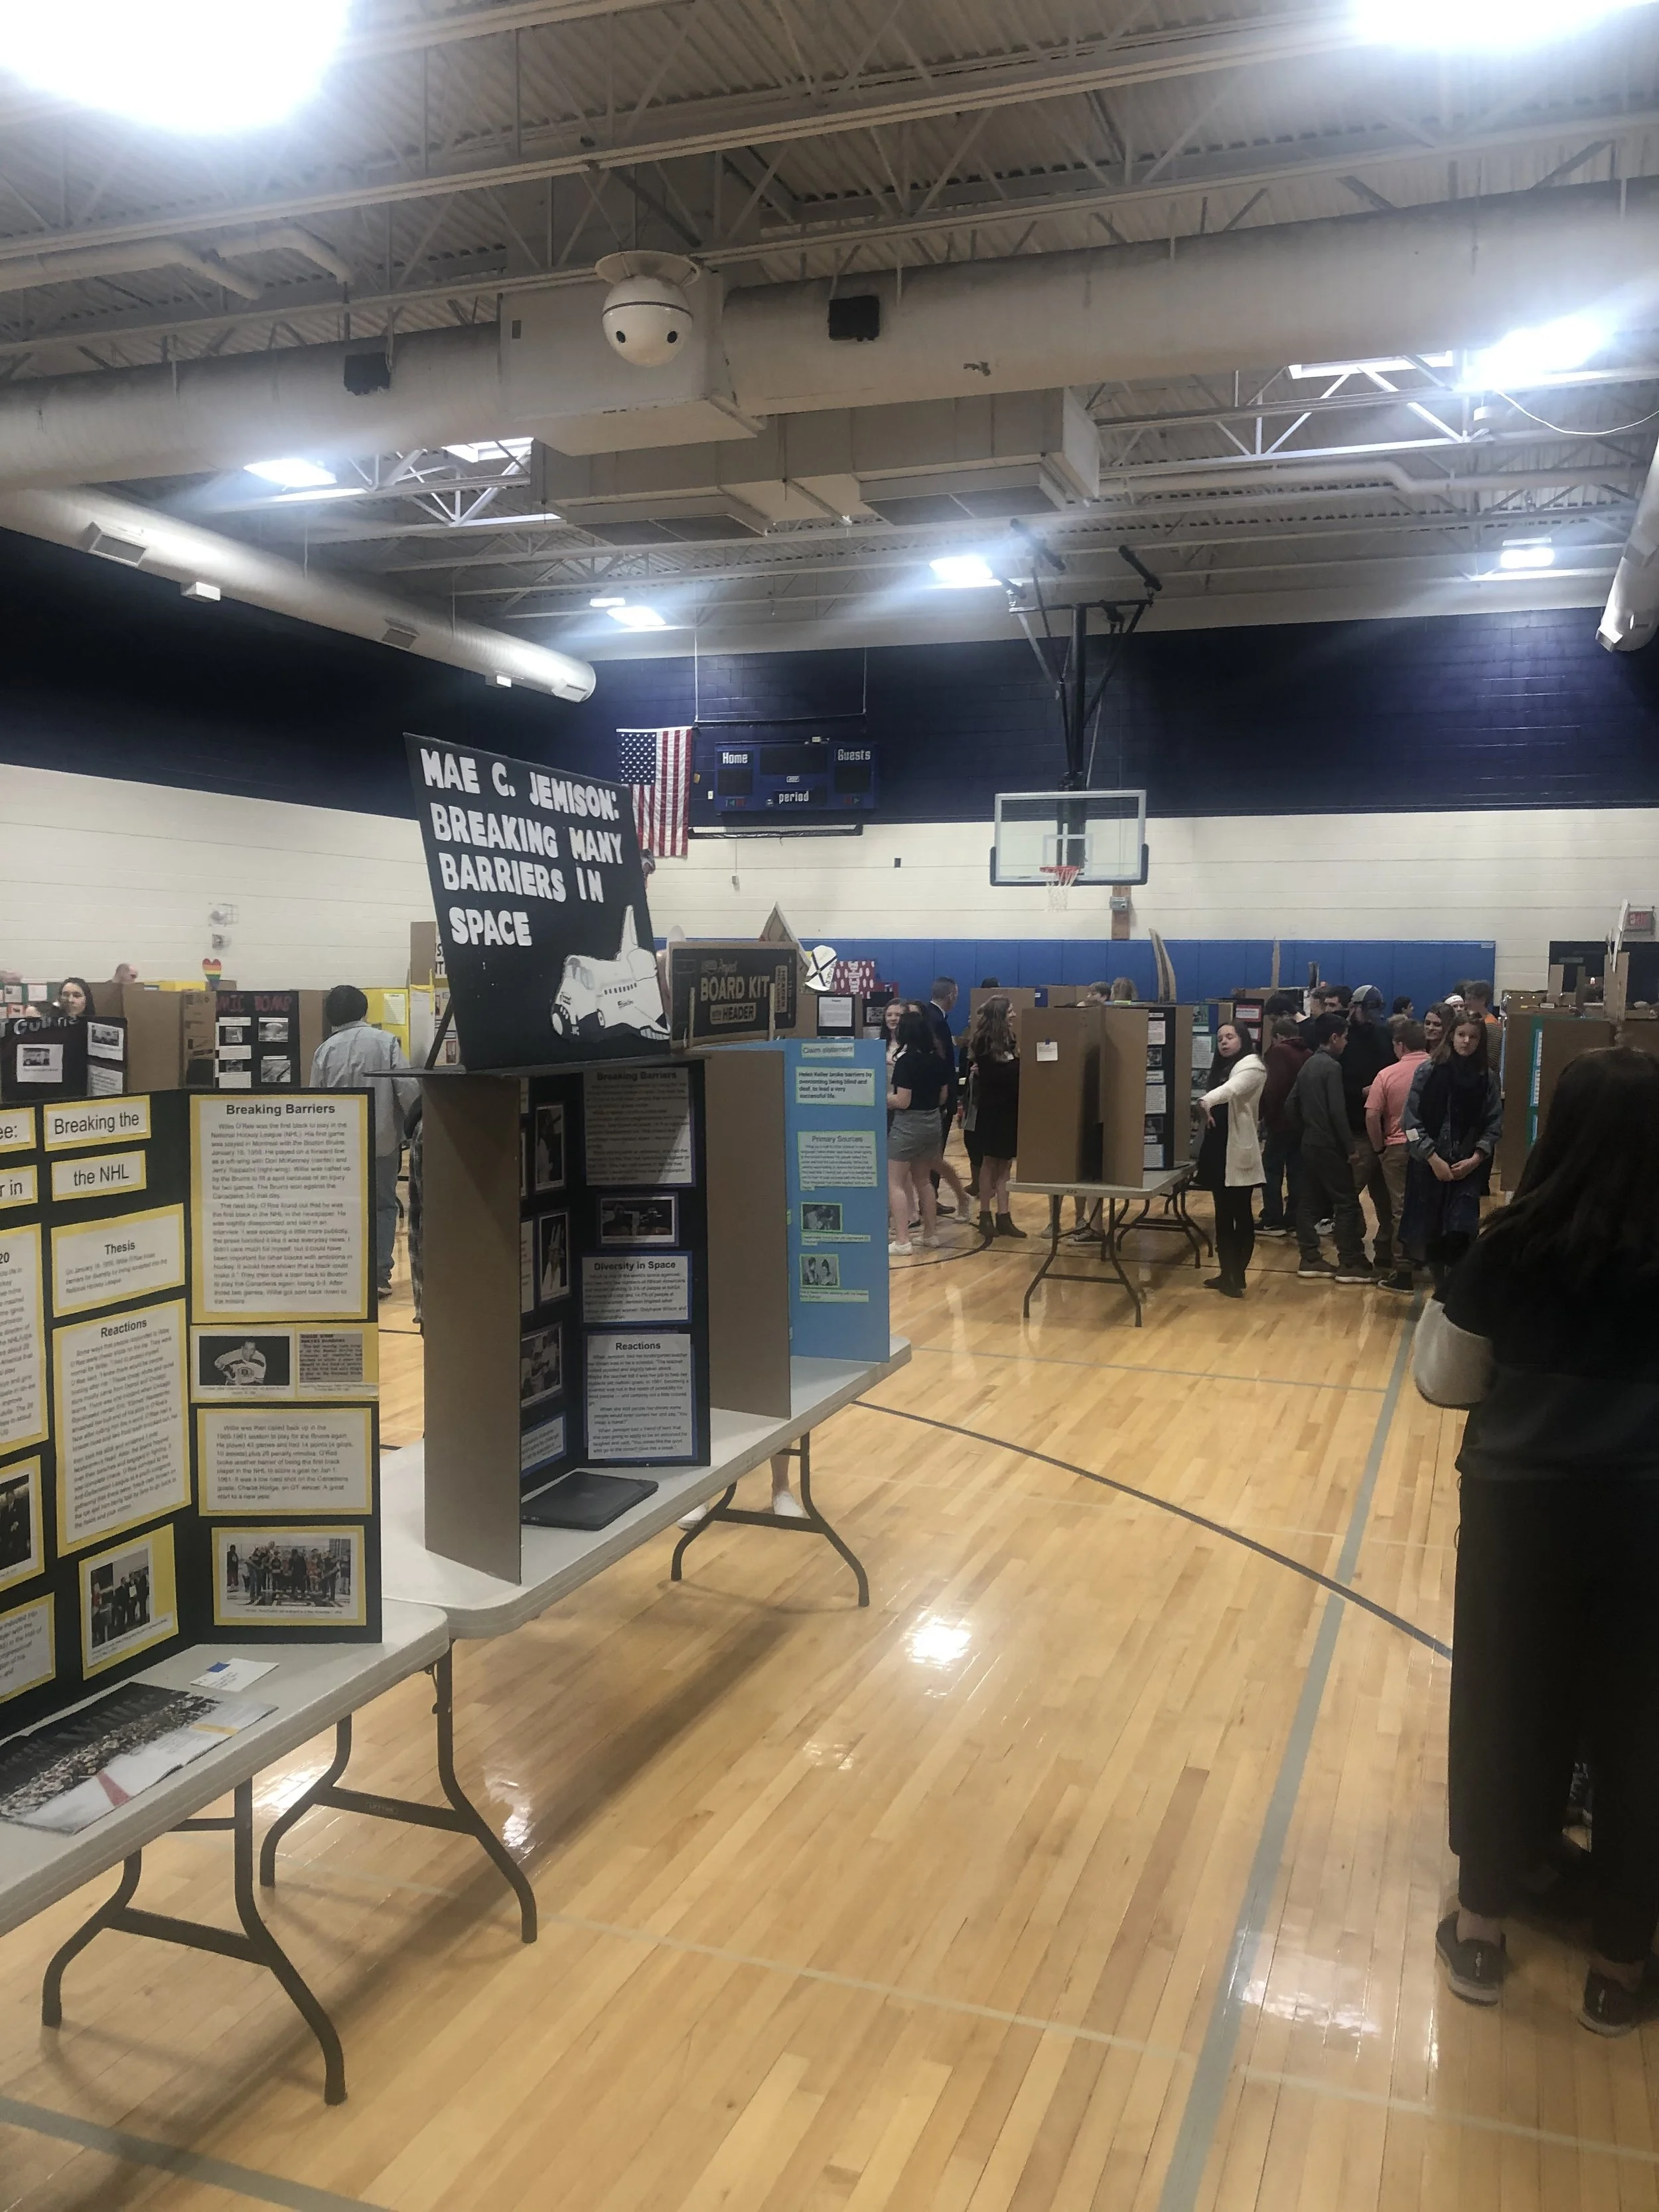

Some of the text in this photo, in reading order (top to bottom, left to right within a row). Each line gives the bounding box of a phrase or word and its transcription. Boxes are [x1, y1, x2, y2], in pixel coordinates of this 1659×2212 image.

[723, 752, 748, 764] Home
[837, 749, 871, 761] Guests
[419, 748, 621, 822] MAE C. JEMISON:
[779, 791, 809, 804] period
[429, 802, 623, 865] BREAKING MANY
[439, 853, 605, 903] BARRIERS IN
[449, 907, 532, 947] SPACE
[700, 976, 745, 1001] BOARD
[749, 976, 770, 998] KIT
[723, 1005, 754, 1021] HEADER
[597, 1072, 637, 1082] Breaking
[226, 1103, 335, 1116] Breaking Barriers
[54, 1112, 139, 1135] Breaking the
[74, 1164, 129, 1186] the NHL
[10, 1179, 23, 1195] in
[104, 1240, 135, 1255] Thesis
[594, 1262, 634, 1271] Diversity
[648, 1261, 676, 1270] Space
[101, 1319, 147, 1338] Reactions
[616, 1342, 661, 1351] Reactions
